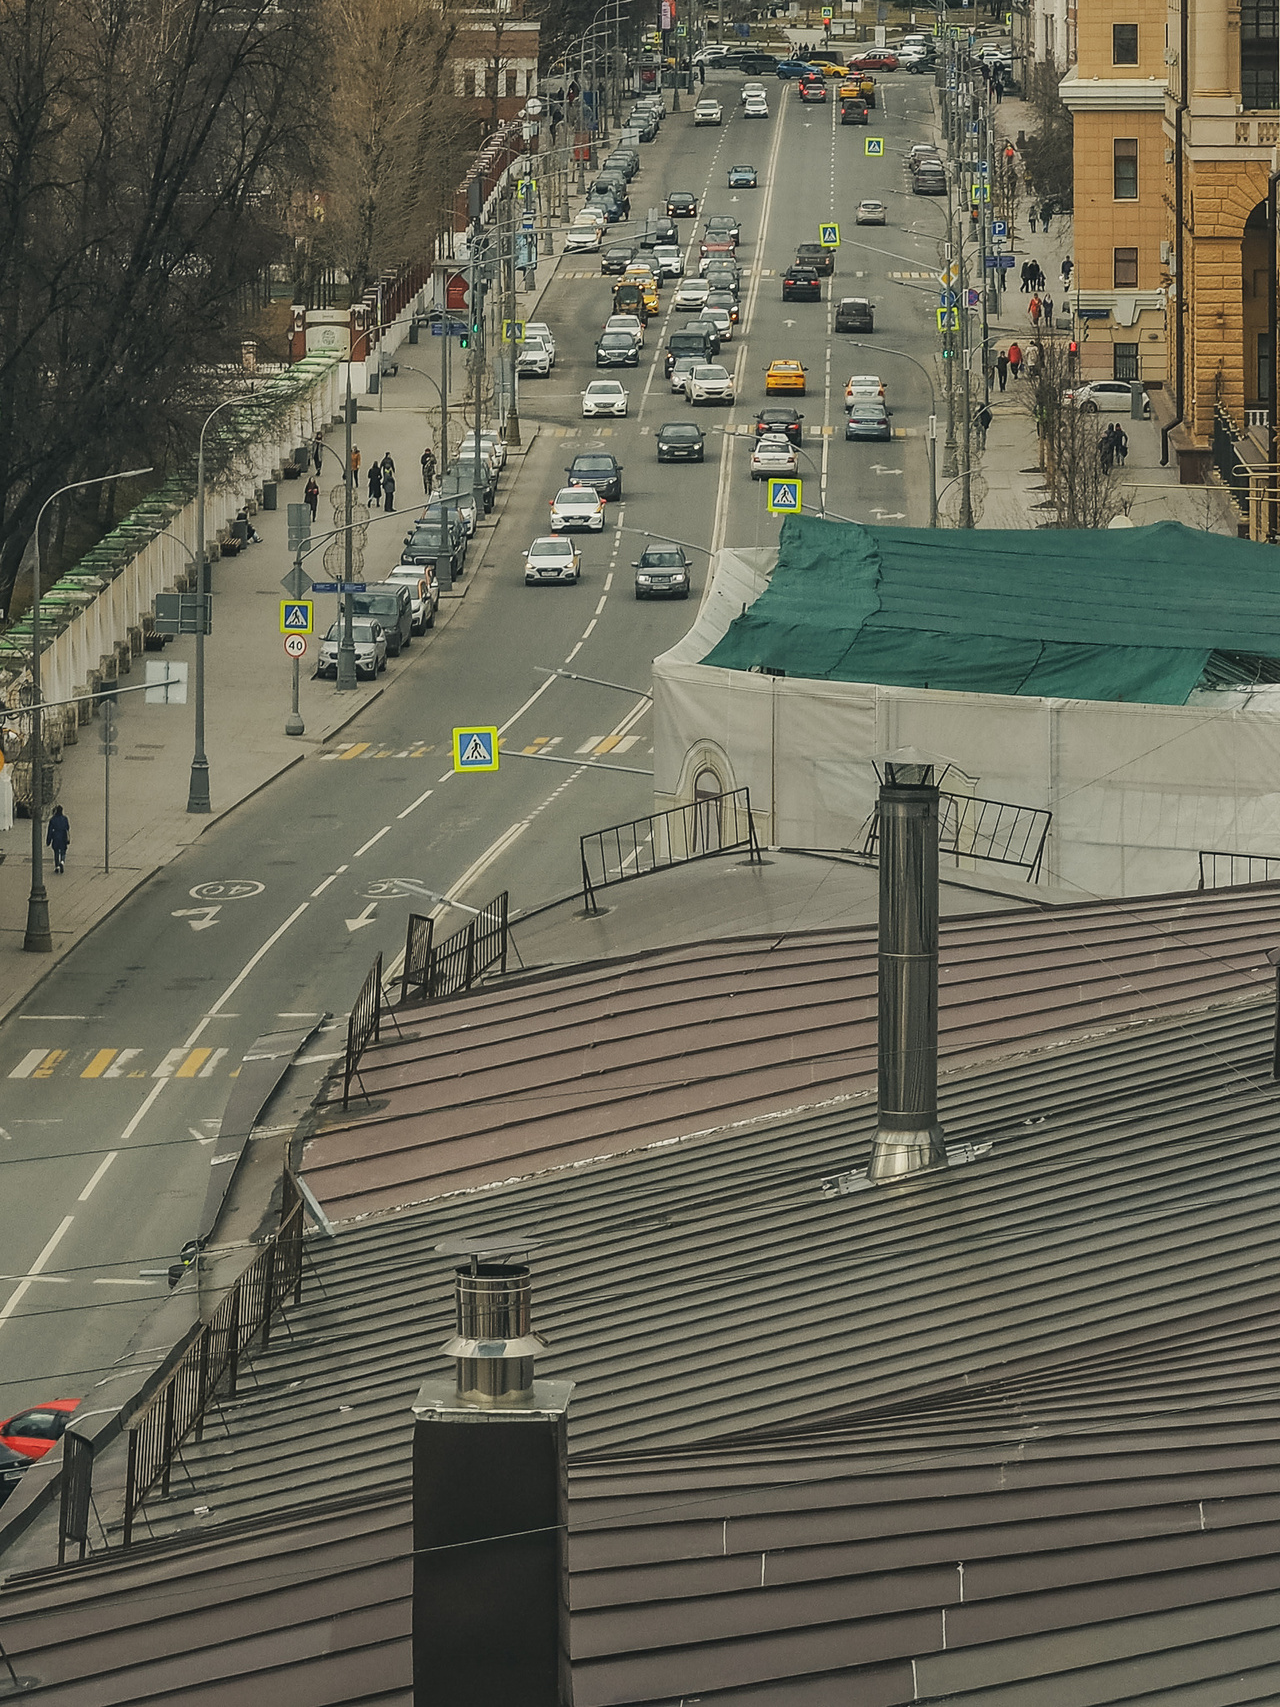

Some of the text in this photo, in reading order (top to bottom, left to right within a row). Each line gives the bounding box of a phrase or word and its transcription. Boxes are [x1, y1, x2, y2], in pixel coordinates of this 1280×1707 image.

[995, 222, 1004, 234] P
[288, 640, 303, 651] 40
[201, 884, 253, 896] 40
